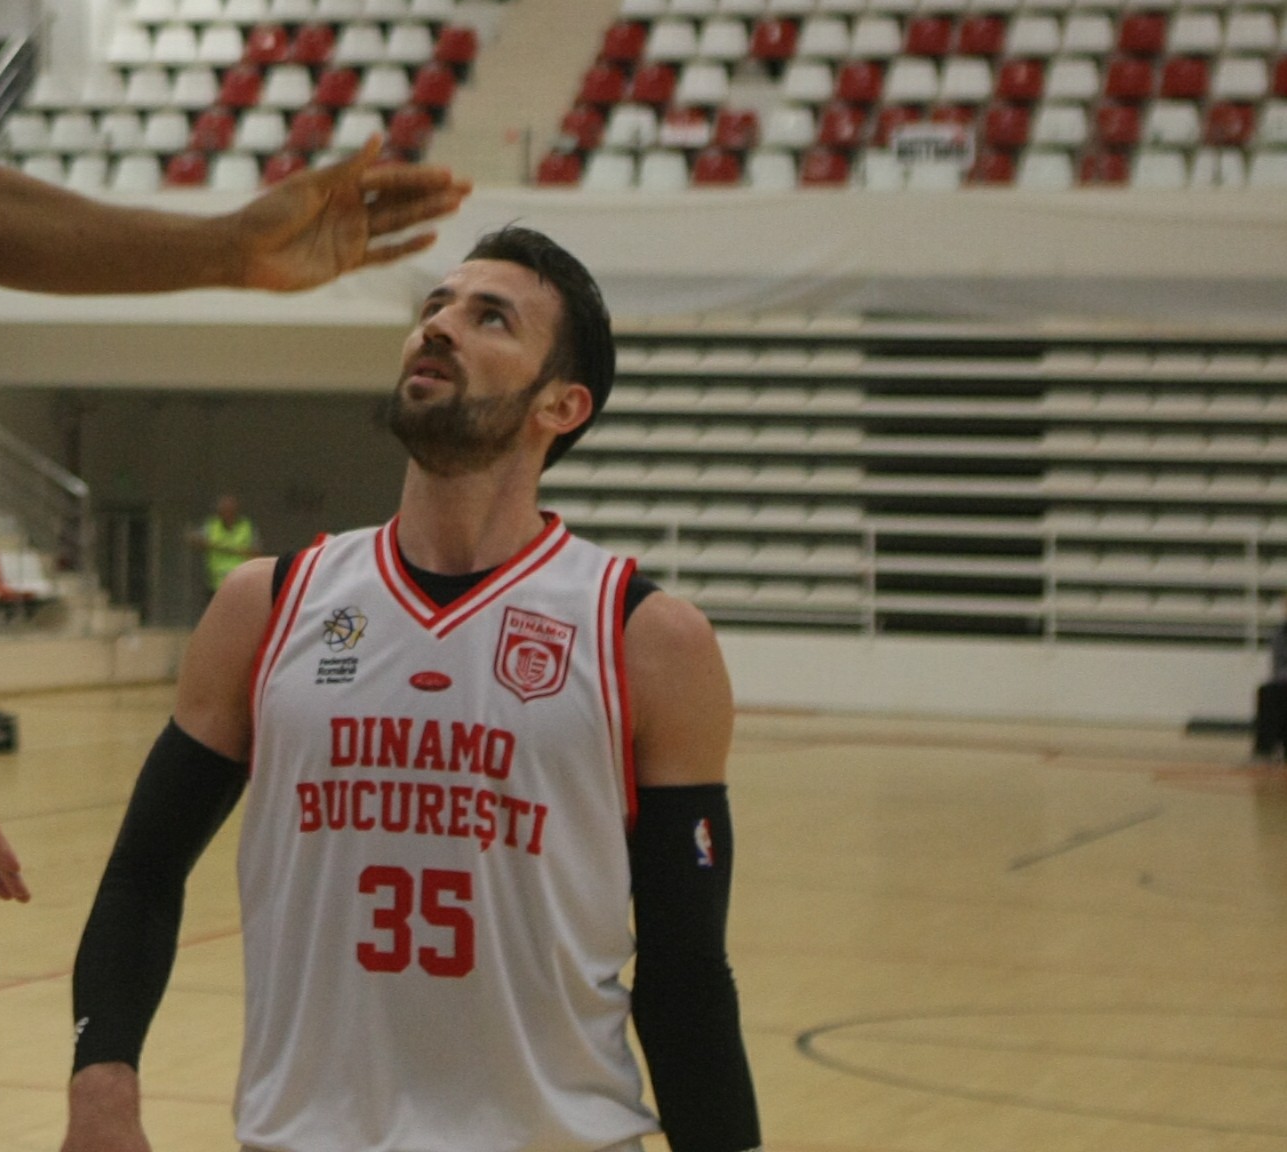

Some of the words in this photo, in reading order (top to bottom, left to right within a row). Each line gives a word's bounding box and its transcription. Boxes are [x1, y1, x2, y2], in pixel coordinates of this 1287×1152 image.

[510, 618, 567, 639] DINAMO
[330, 717, 516, 780] DINAMO
[357, 865, 476, 978] 35
